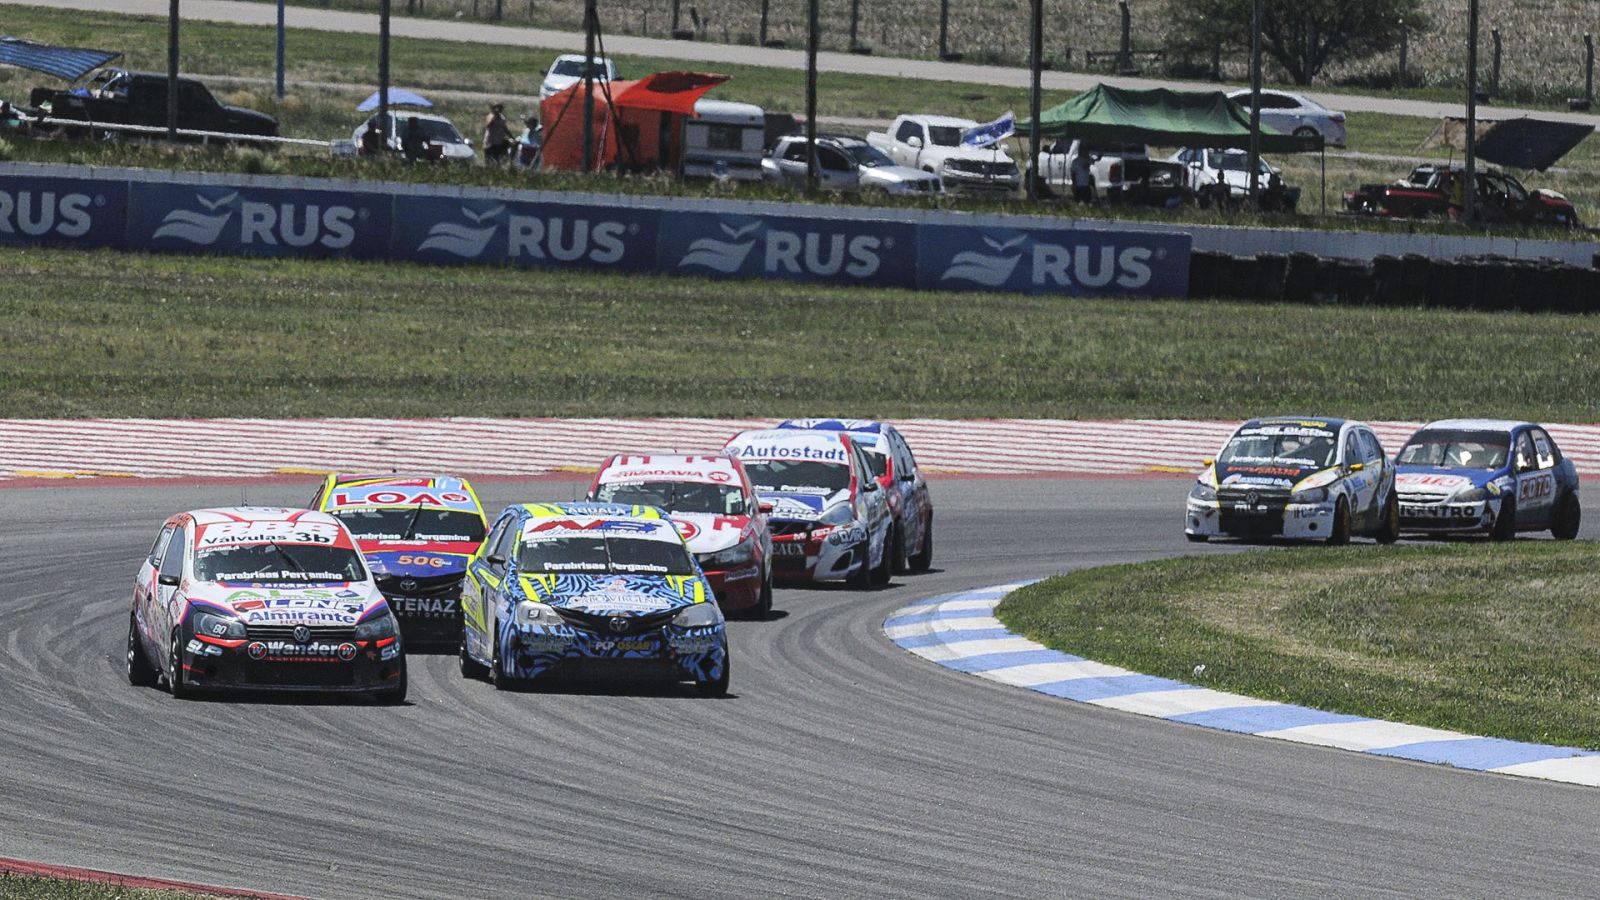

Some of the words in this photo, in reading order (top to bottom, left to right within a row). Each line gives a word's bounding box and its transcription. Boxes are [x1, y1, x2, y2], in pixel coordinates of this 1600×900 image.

[240, 200, 357, 249] RUS
[508, 213, 627, 264] RUS
[763, 229, 881, 279] RUS
[1031, 242, 1153, 289] RUS
[741, 444, 846, 461] Autostadt
[336, 491, 443, 506] LOA
[295, 531, 331, 543] 3b
[415, 533, 470, 542] Pergamino
[543, 561, 606, 570] Parabrisas
[609, 562, 668, 573] Pergamino
[216, 570, 278, 581] Parabrisas
[392, 597, 456, 613] TENAZ
[249, 611, 356, 624] Almirante
[267, 641, 339, 656] Wander
